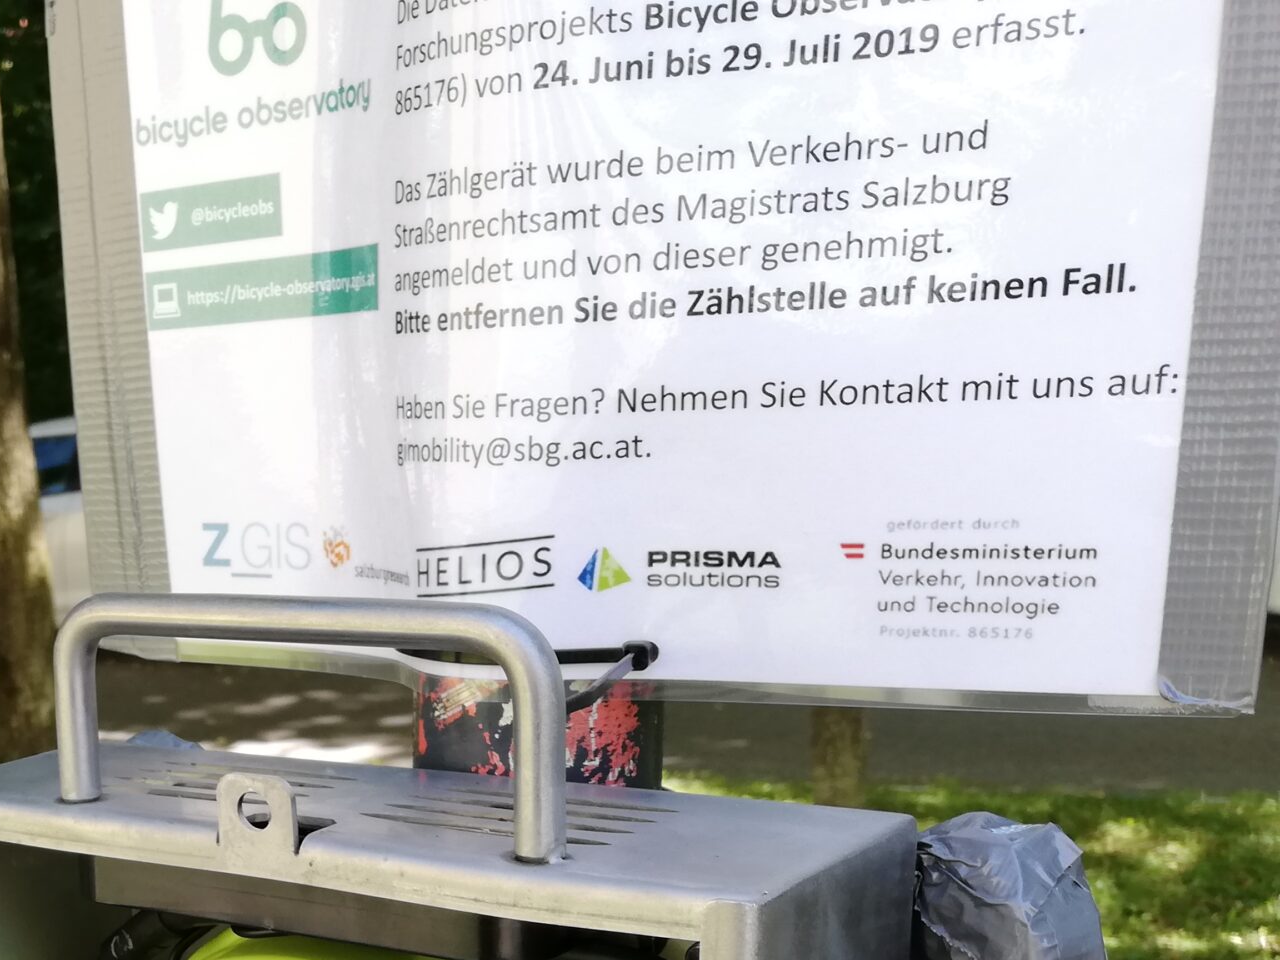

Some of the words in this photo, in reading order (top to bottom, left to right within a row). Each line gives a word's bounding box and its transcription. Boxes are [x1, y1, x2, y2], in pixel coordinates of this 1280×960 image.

[397, 0, 419, 24] Die
[396, 7, 632, 71] Forschungsprojekts
[645, 0, 758, 33] Bicycle
[395, 73, 467, 115] 865176)
[475, 71, 522, 98] von
[533, 60, 578, 89] 24.
[589, 51, 653, 84] Juni
[666, 49, 711, 78] bis
[722, 42, 771, 72] 29.
[784, 33, 840, 68] Juli
[852, 24, 939, 61] 2019
[952, 11, 1085, 49] erfasst.
[136, 105, 228, 148] bicycle
[237, 78, 371, 129] observatory
[395, 179, 420, 204] Das
[426, 161, 537, 199] Zählgerät
[548, 150, 643, 184] wurde
[657, 144, 735, 175] beim
[748, 131, 908, 169] Verkehrs-
[922, 119, 989, 155] und
[191, 199, 274, 226] @bicycleobs
[395, 206, 600, 249] Straßenrechtsamt
[612, 199, 664, 227] des
[676, 184, 850, 225] Magistrats
[861, 172, 1011, 209] Salzburg
[395, 256, 513, 297] angemeldet
[523, 250, 576, 281] und
[587, 250, 641, 277] von
[652, 240, 751, 272] dieser
[761, 226, 953, 270] genehmigt.
[395, 307, 430, 336] Bitte
[437, 299, 564, 331] entfernen
[574, 295, 618, 323] Sie
[628, 290, 676, 320] die
[686, 281, 848, 317] Zählstelle
[858, 276, 918, 308] auf
[926, 267, 1049, 304] keinen
[1062, 262, 1137, 296] Fall.
[396, 394, 445, 421] Haben
[452, 394, 485, 420] Sie
[495, 388, 604, 423] Fragen?
[617, 385, 748, 414] Nehmen
[761, 380, 806, 409] Sie
[820, 374, 949, 406] Kontakt
[961, 373, 1019, 402] mit
[1031, 376, 1094, 400] uns
[1106, 364, 1179, 397] auf:
[397, 433, 652, 468] gimobility@sbg.ac.at.
[972, 518, 1020, 530] durch
[417, 547, 552, 588] HELIOS
[647, 551, 781, 570] PRISMA
[880, 542, 1098, 560] Bundesministerium
[647, 570, 780, 589] solutions
[878, 569, 965, 589] Verkehr,
[976, 570, 1097, 588] Innovation
[877, 596, 916, 613] und
[926, 596, 1060, 619] Technologie
[880, 625, 960, 639] Projektnr.
[968, 626, 1033, 640] 865176
